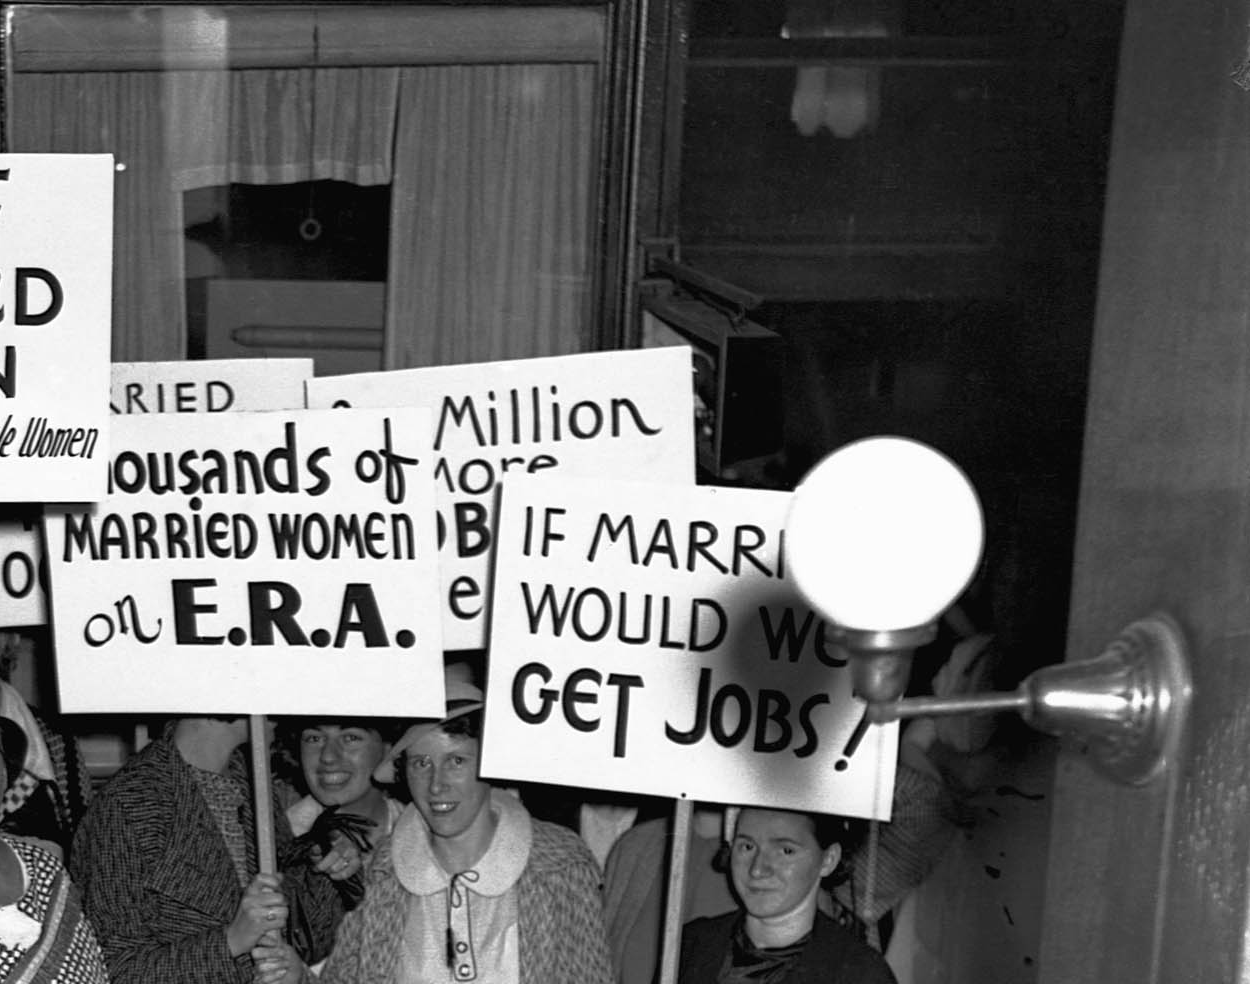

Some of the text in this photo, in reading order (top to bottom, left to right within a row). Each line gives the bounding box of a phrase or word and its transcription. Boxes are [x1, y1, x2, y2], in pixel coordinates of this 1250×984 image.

[18, 417, 98, 460] Women
[434, 385, 662, 450] Million
[107, 418, 418, 504] ousands of
[268, 513, 415, 560] WOMEN
[523, 506, 566, 557] IF
[84, 578, 417, 648] on E.R.A.
[520, 582, 729, 652] WOULD
[511, 662, 644, 758] GET
